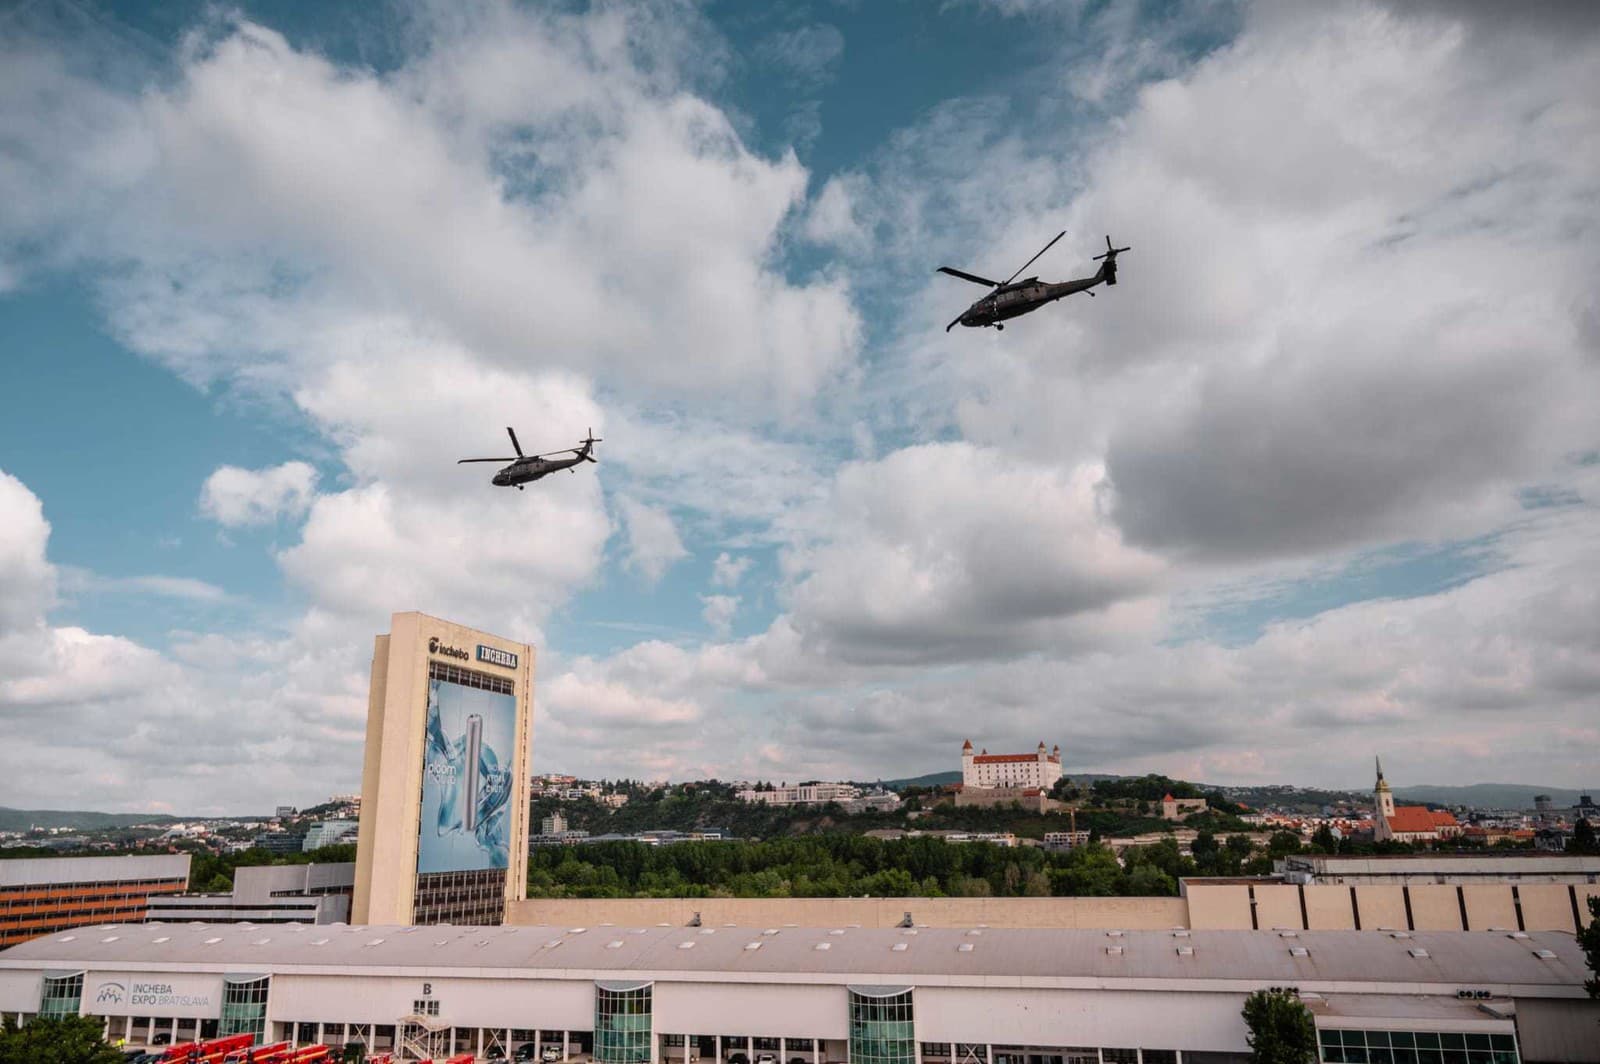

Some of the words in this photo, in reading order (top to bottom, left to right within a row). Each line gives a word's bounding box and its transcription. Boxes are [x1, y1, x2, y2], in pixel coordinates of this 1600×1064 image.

[481, 646, 516, 667] INCHEBA
[133, 984, 173, 994] INCHEBA
[423, 983, 432, 995] B
[131, 995, 157, 1005] EXPO
[159, 996, 209, 1006] BRATISLAVA
